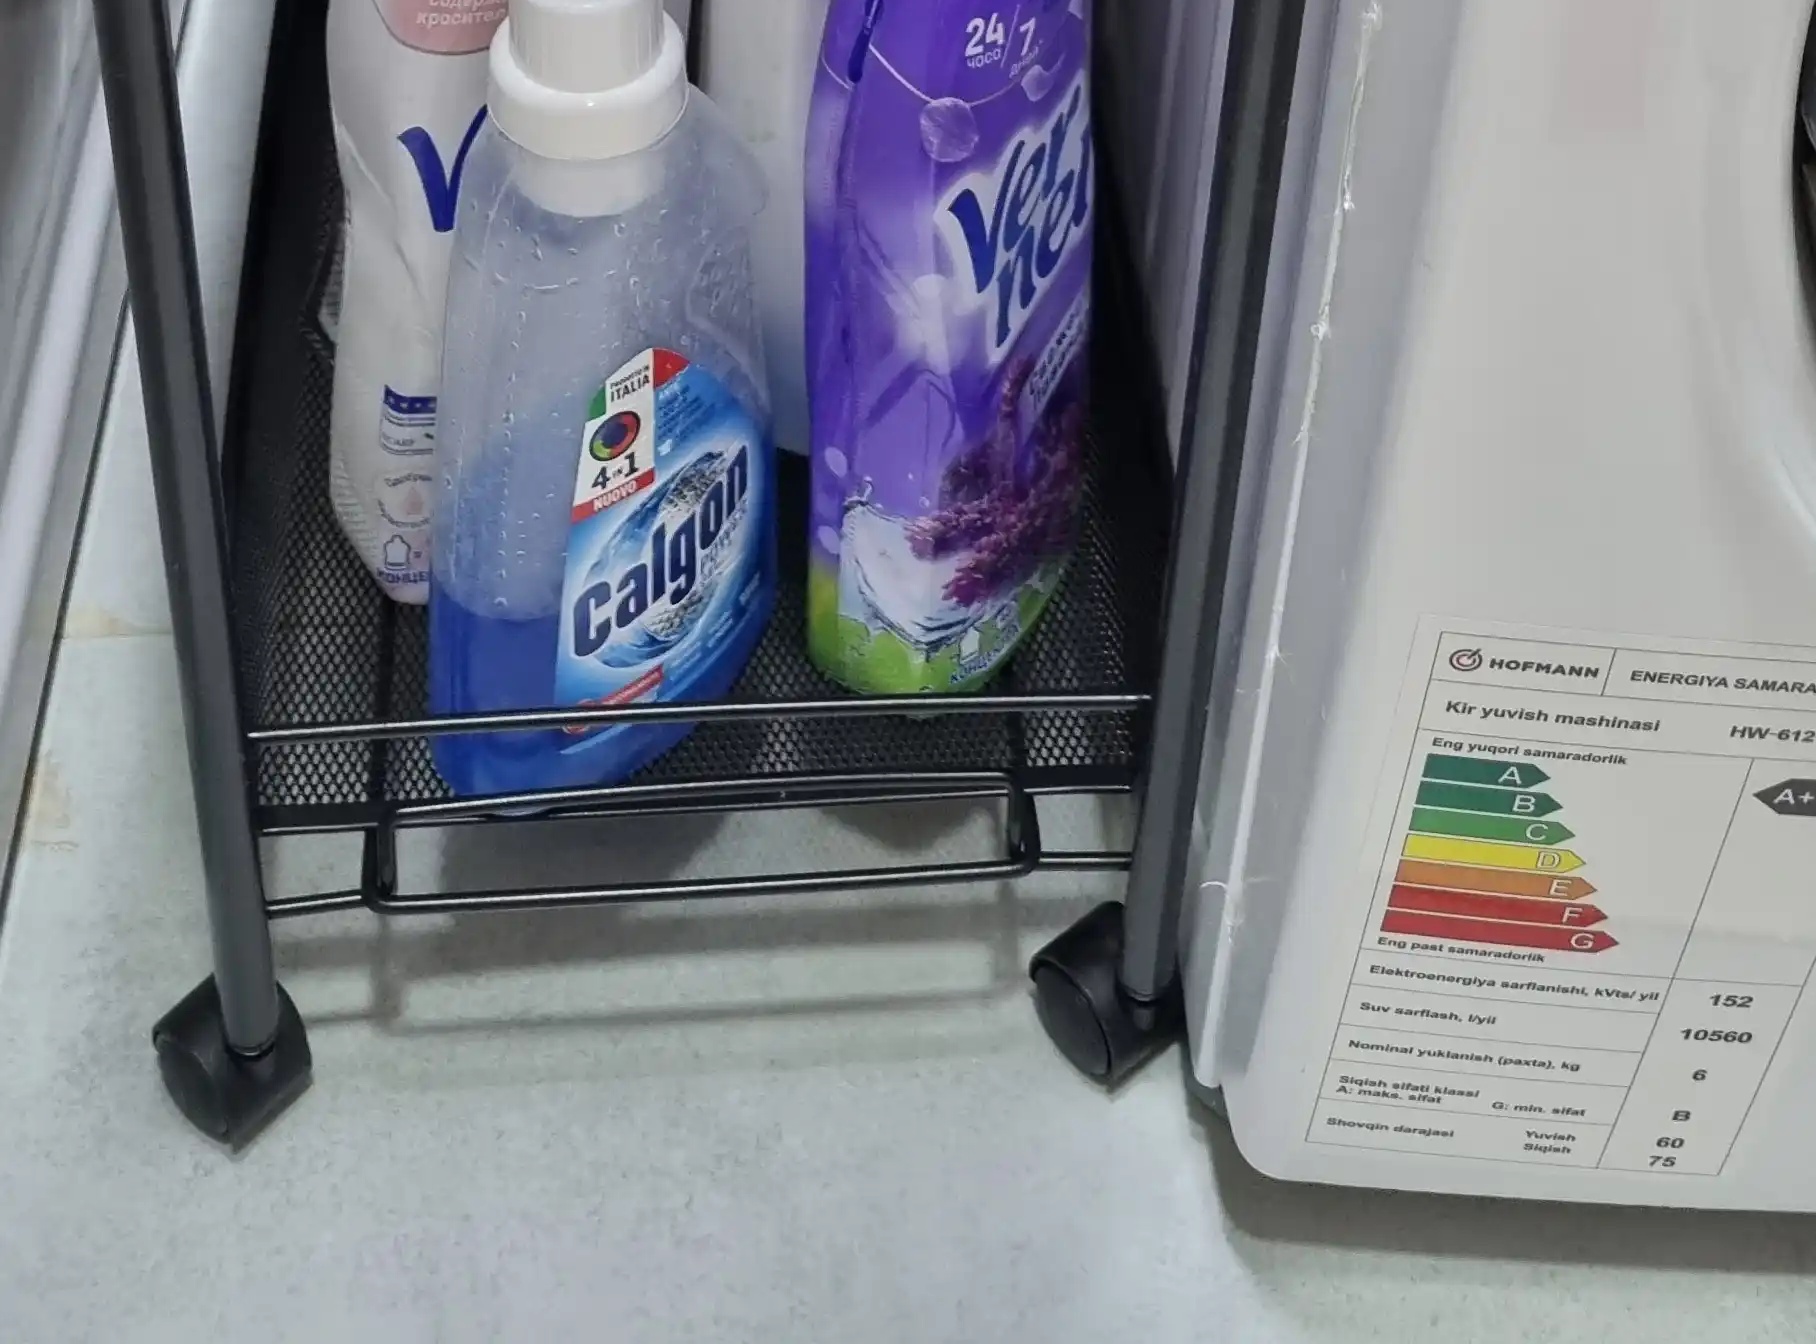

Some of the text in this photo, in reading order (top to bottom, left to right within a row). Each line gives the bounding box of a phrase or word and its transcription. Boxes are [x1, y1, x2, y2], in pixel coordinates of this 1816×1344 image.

[610, 374, 651, 403] ITALIA
[591, 466, 612, 490] 4
[624, 452, 640, 478] 1
[593, 480, 638, 512] NUOVO
[573, 444, 749, 657] Calgon
[1489, 657, 1600, 679] HOFMANN
[1630, 670, 1729, 689] ENERGIYA
[1445, 700, 1661, 732] Kir yuvish mashinasi
[1729, 725, 1816, 743] HW-612
[1432, 737, 1628, 765] Eng yuqori samaradorlik
[1498, 765, 1522, 785] A
[1512, 794, 1537, 813] B
[1525, 823, 1549, 841] C
[1536, 850, 1561, 870] D
[1550, 879, 1573, 897] E
[1562, 906, 1583, 924] F
[1377, 936, 1546, 963] Eng past samaradorlik
[1570, 932, 1595, 950] G
[1369, 964, 1497, 988] Elektroenergiya
[1360, 1001, 1391, 1013] Suv
[1709, 993, 1754, 1009] 152
[1681, 1028, 1753, 1044] 10560
[1348, 1039, 1414, 1055] Nominal
[1417, 1048, 1494, 1063] yuklanish
[1561, 1061, 1581, 1072] kg
[1692, 1069, 1708, 1082] 6
[1336, 1085, 1353, 1095] A:
[1408, 1094, 1442, 1104] sifat
[1339, 1075, 1480, 1098] Siqish sifati klassi
[1552, 1107, 1587, 1117] sifat
[1672, 1110, 1692, 1122] B
[1326, 1117, 1454, 1138] Shovqin darajasi
[1525, 1130, 1577, 1142] Yuvish
[1523, 1143, 1572, 1154] Siqish
[1656, 1137, 1685, 1150] 60
[1648, 1155, 1677, 1167] 75
